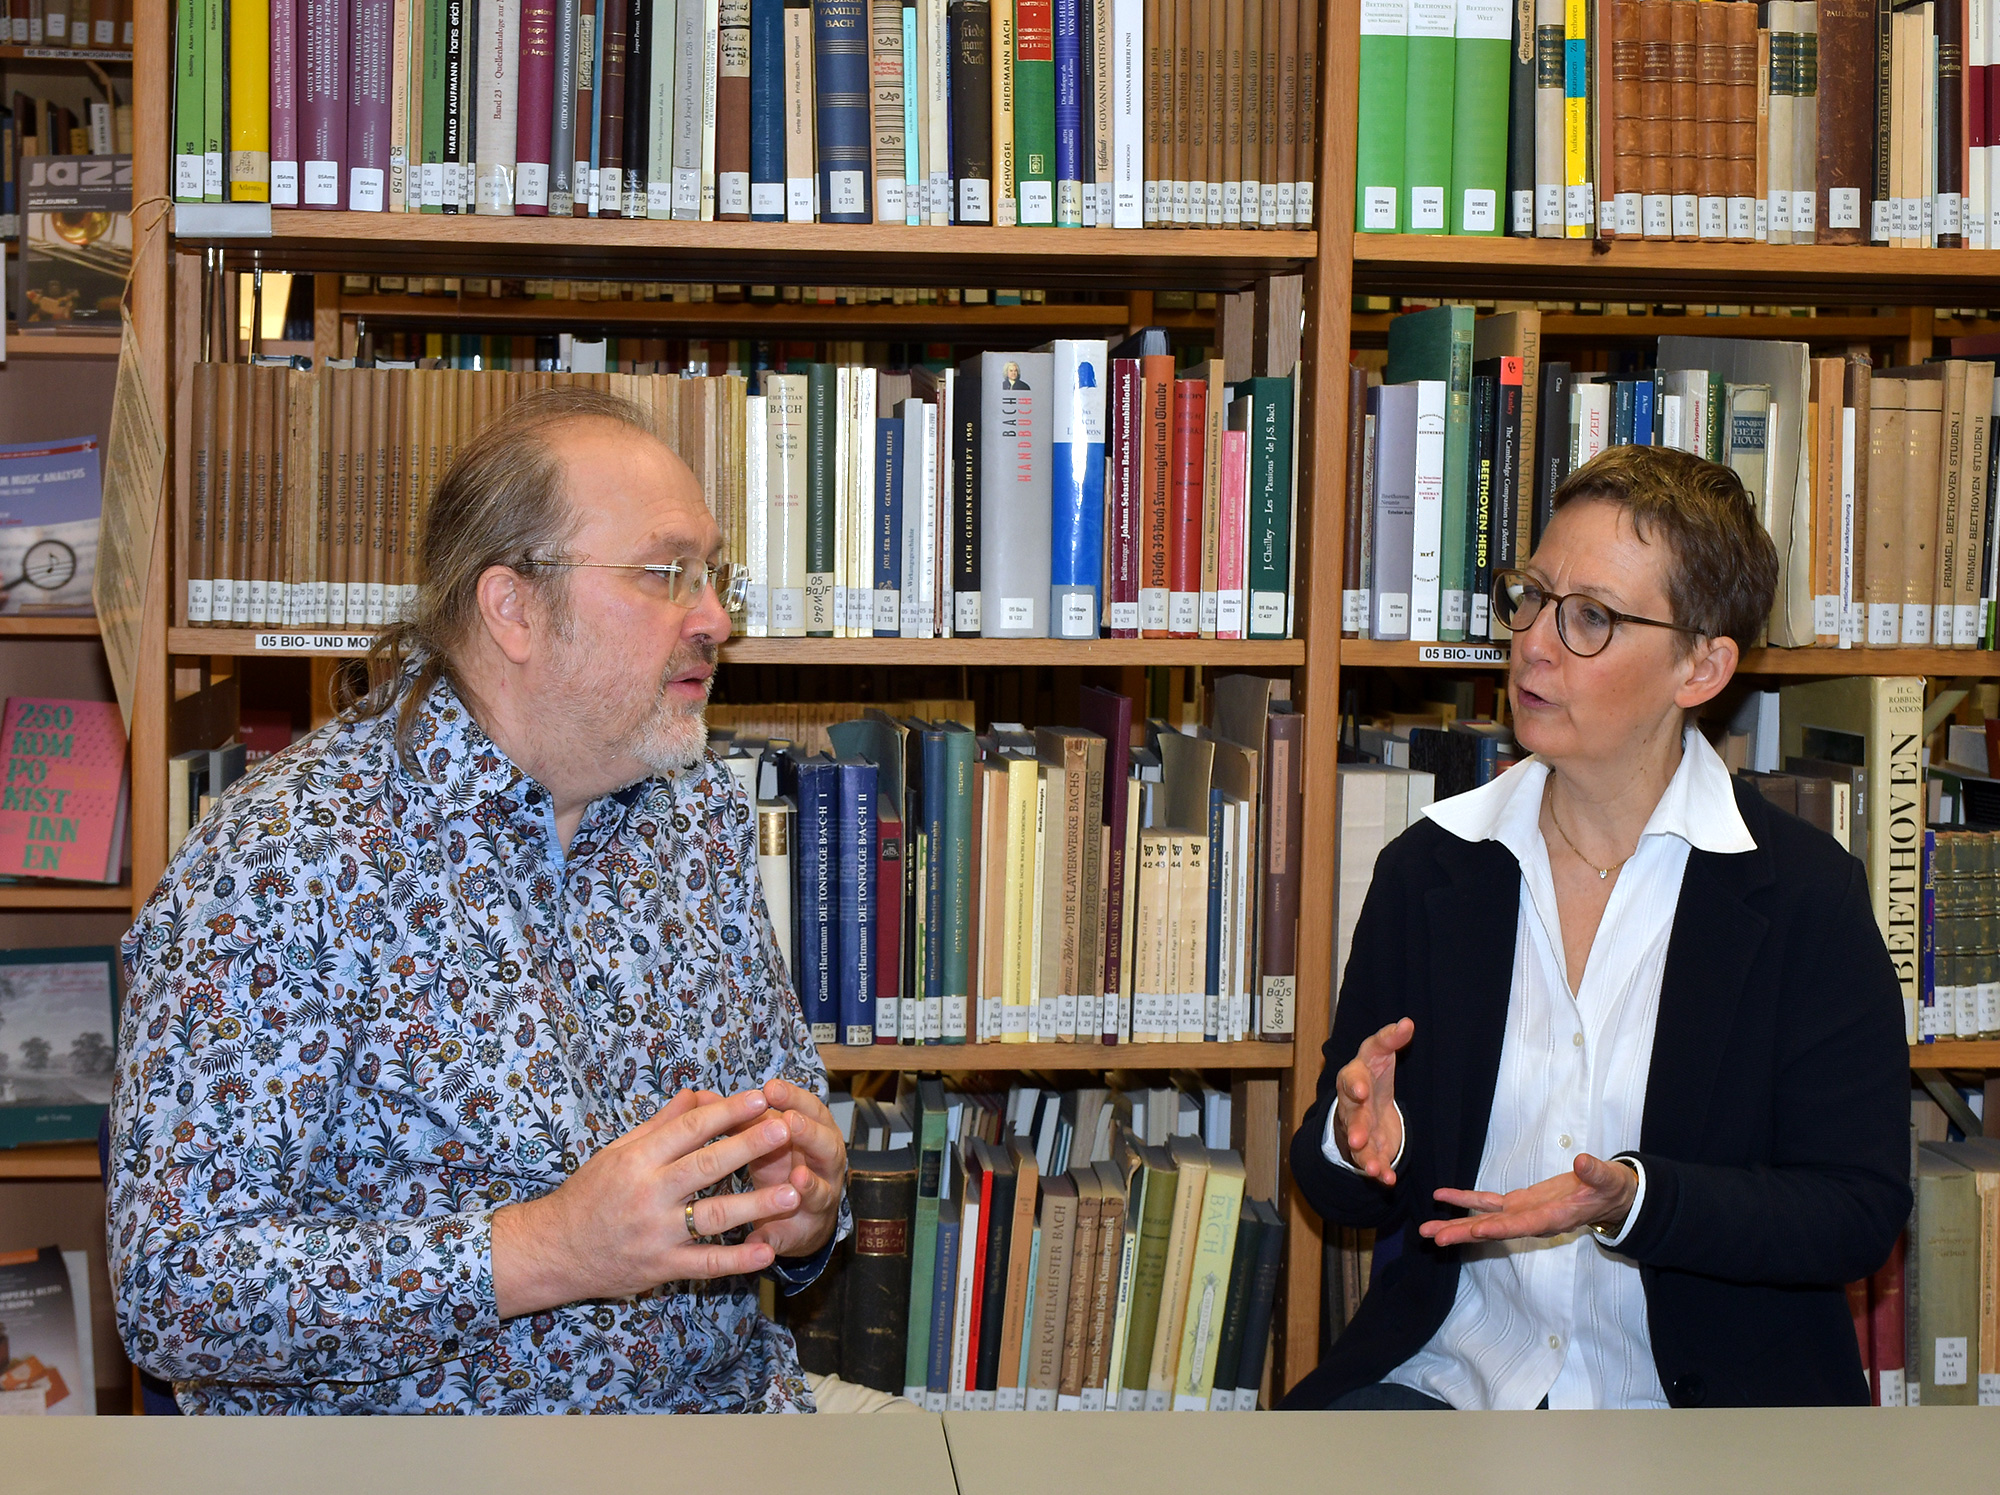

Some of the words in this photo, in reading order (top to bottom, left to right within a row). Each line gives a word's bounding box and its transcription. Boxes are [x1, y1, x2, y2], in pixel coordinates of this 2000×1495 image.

[450, 3, 459, 25] erich
[449, 29, 459, 53] hans
[495, 19, 504, 79] Quellenkataloge
[563, 34, 571, 66] MONACO
[1098, 36, 1106, 78] BATTISTA
[449, 62, 457, 114] KAUFMANN
[1003, 50, 1011, 112] FRIEDEMANN
[494, 99, 502, 119] Band
[561, 104, 569, 129] GUIDO
[28, 161, 132, 187] jazz
[1523, 328, 1536, 387] GESTALT
[1657, 377, 1664, 385] 33
[770, 405, 802, 414] BACH
[817, 385, 825, 407] BACH
[1122, 374, 1131, 439] Notenbibliothek
[1507, 391, 1515, 415] Stanley
[1523, 391, 1534, 415] DIE
[1003, 398, 1016, 437] BACH
[1266, 403, 1275, 422] Bach
[1589, 409, 1600, 437] ZEIT
[1668, 406, 1676, 441] Rezeption
[1018, 398, 1031, 482] HANDBUCH
[1520, 419, 1533, 451] UND
[1733, 436, 1764, 444] HOVEN
[1734, 428, 1764, 436] BEET
[1950, 420, 1959, 466] STUDIEN
[1121, 441, 1130, 466] Bachs
[1266, 443, 1274, 452] de
[1502, 439, 1512, 478] Cambridge
[1973, 425, 1982, 471] STUDIEN
[11, 472, 41, 485] MUSIC
[43, 468, 85, 482] ANALYSIS
[1121, 468, 1130, 507] Sebastian
[1264, 500, 1273, 513] Les
[1478, 460, 1490, 529] BEETHOVEN
[1502, 480, 1510, 519] Companion
[1516, 456, 1530, 539] BEETHOVEN
[1946, 468, 1956, 534] BEETHOVEN
[1969, 474, 1980, 539] BEETHOVEN
[1121, 509, 1131, 538] Johann
[1264, 529, 1276, 563] Chailley
[1477, 534, 1487, 567] HERO
[1500, 530, 1510, 561] Beethoven
[1120, 544, 1128, 581] Beißwenger
[806, 585, 832, 596] BaJF
[811, 576, 823, 585] 05
[814, 595, 824, 623] W846
[261, 636, 277, 647] 05
[281, 636, 310, 647] BIO-
[314, 637, 343, 648] UND
[1425, 649, 1439, 659] 05
[1443, 649, 1470, 659] BIO-
[1474, 650, 1502, 660] UND
[17, 705, 74, 729] 250
[11, 732, 73, 757] KOM
[8, 758, 48, 782] PO
[2, 787, 71, 813] NIST
[1070, 773, 1080, 812] BACHS
[1089, 771, 1101, 809] BACHS
[29, 818, 79, 843] INN
[819, 806, 827, 844] B-A-C-H
[858, 806, 867, 844] B-A-C-H
[22, 845, 62, 870] EN
[1067, 816, 1079, 902] KLAVIERWERKE
[1087, 812, 1099, 893] ORGELWERKE
[1889, 730, 1917, 984] BEETHOVEN
[819, 847, 828, 902] TONFOLGE
[859, 847, 867, 902] TONFOLGE
[819, 904, 827, 921] DIE
[858, 904, 867, 922] DIE
[1066, 904, 1076, 924] DIE
[1087, 896, 1095, 914] DIE
[1111, 910, 1119, 929] UND
[819, 927, 828, 970] Hartmann
[859, 927, 867, 971] Hartmann
[1110, 934, 1118, 958] BACH
[819, 972, 829, 1001] Günter
[858, 973, 869, 1002] Günter
[1267, 987, 1292, 997] BaJS
[1273, 978, 1285, 987] 05
[1053, 1205, 1067, 1240] BACH
[1076, 1218, 1093, 1285] Kammermusik
[1042, 1244, 1063, 1344] KAPELLMEISTER
[1074, 1287, 1088, 1310] Bachs
[1070, 1313, 1083, 1356] Sebastian
[1040, 1351, 1053, 1376] DER
[1066, 1358, 1079, 1391] Johann
